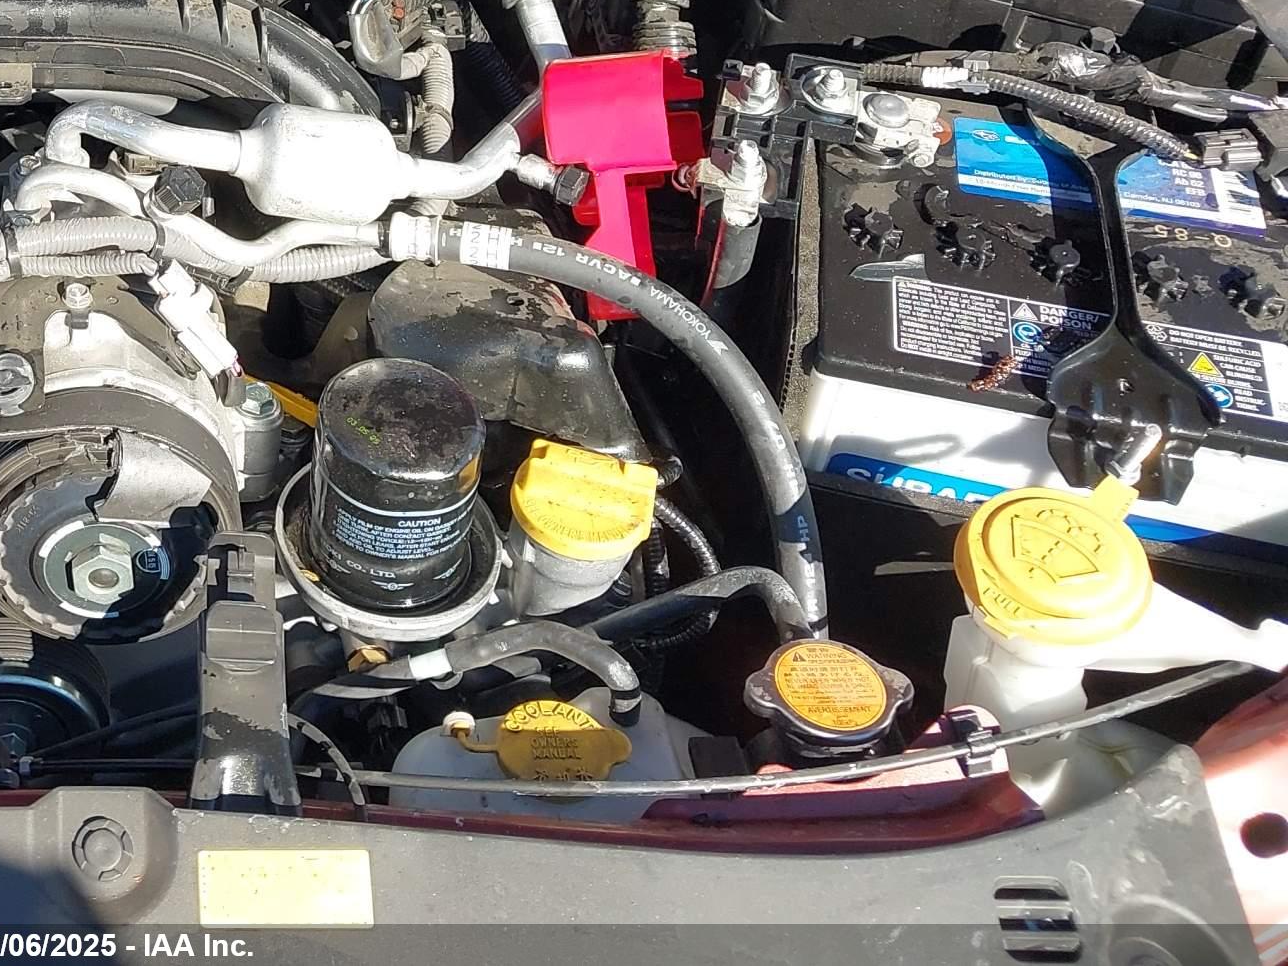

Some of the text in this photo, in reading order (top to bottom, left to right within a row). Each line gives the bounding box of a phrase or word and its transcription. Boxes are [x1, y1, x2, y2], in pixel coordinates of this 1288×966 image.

[649, 285, 711, 340] YOKOHAMA
[1039, 304, 1100, 323] DANGER/
[1040, 314, 1092, 331] POISON
[397, 516, 442, 528] CAUTION
[504, 700, 595, 732] COOLANT
[531, 737, 578, 749] OWNERS
[533, 748, 581, 760] MANUAL
